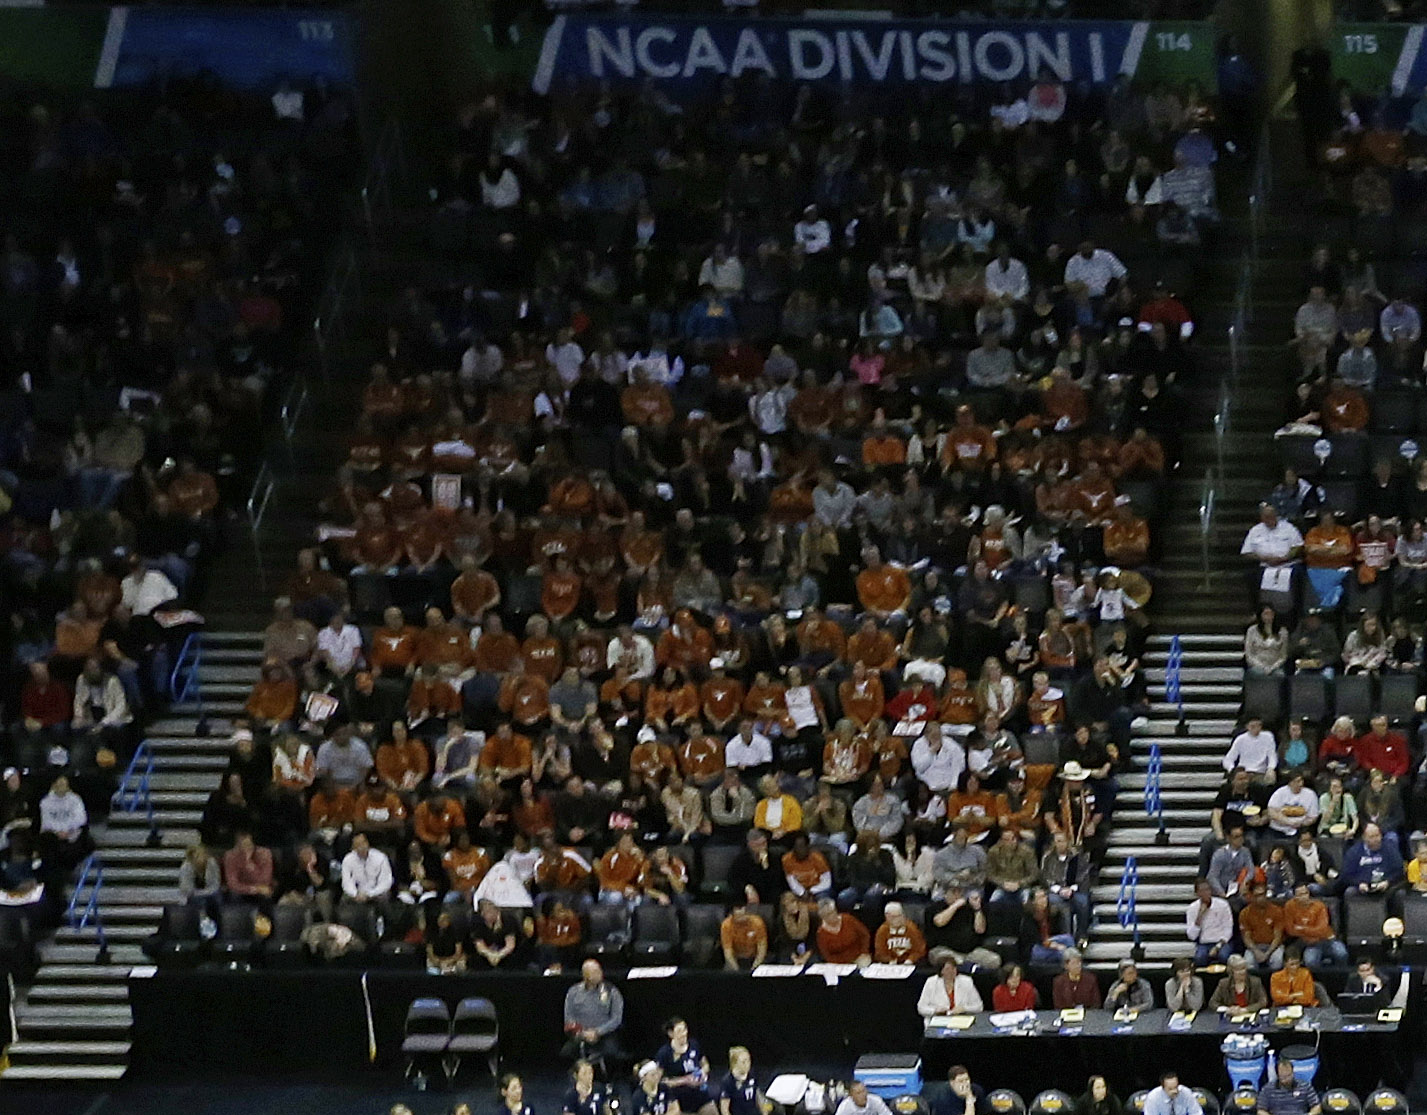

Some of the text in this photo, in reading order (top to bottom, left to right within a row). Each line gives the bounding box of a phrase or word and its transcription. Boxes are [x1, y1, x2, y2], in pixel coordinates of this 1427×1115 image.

[1156, 33, 1193, 52] 114
[1344, 34, 1379, 54] 115
[587, 26, 776, 80] NCAA
[788, 26, 1071, 82] DIVISION
